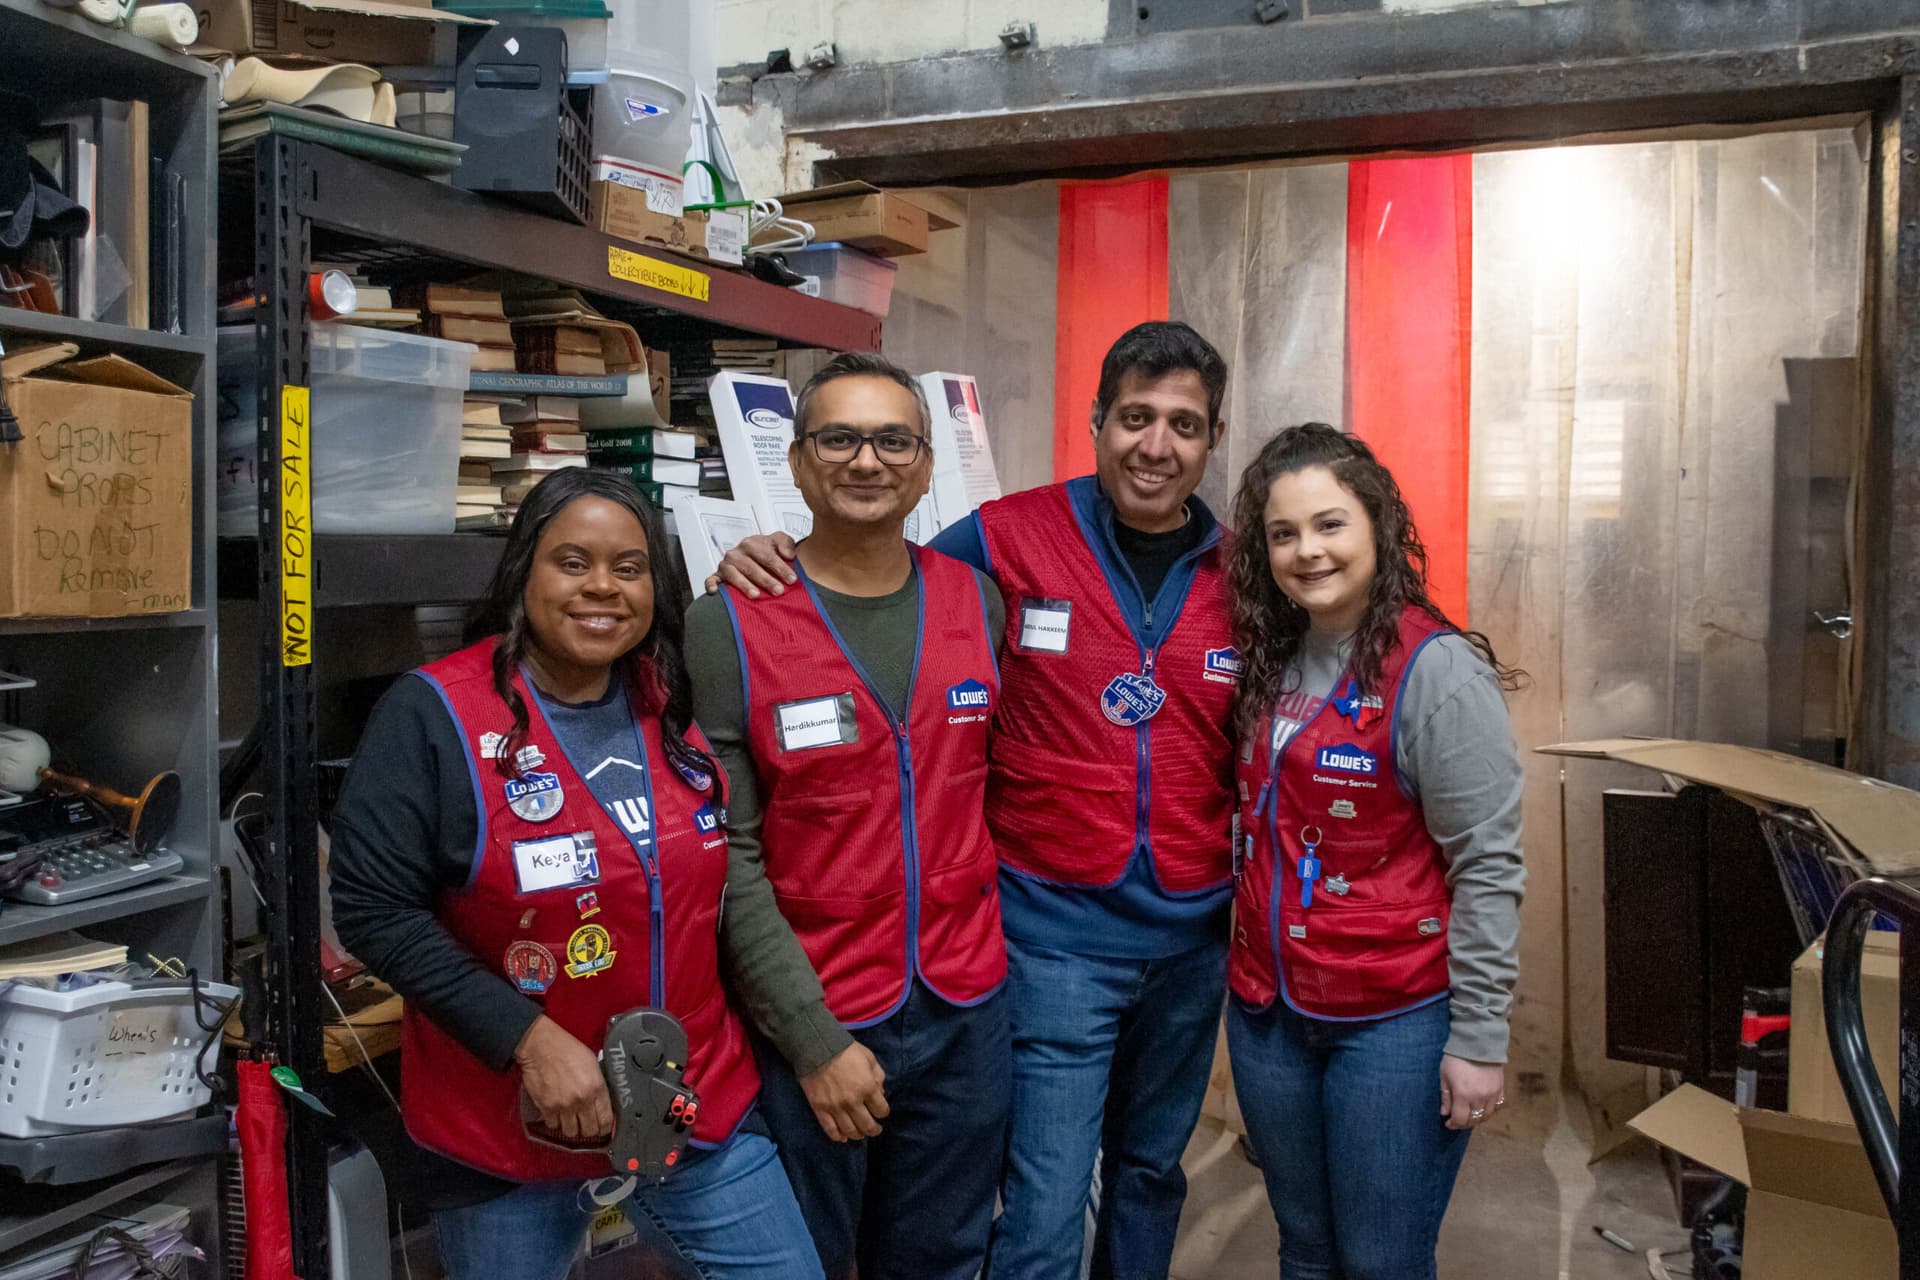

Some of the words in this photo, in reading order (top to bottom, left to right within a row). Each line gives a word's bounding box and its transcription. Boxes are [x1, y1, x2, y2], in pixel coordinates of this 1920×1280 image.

[610, 260, 658, 284] COLLECTIBLE
[657, 273, 680, 289] BOOKS
[500, 376, 544, 389] GEOGRAPHIC
[545, 378, 566, 389] ATLAS
[566, 378, 575, 389] OF
[576, 379, 589, 390] THE
[590, 380, 614, 391] WORLD
[35, 420, 171, 467] CABINET
[281, 396, 304, 499] SALE
[600, 438, 614, 448] Golf
[60, 468, 153, 508] PROPS
[33, 526, 81, 560] DO
[88, 522, 161, 559] NOT
[283, 509, 306, 579] FOR
[59, 556, 153, 593] Remove
[284, 588, 308, 657] NOT
[951, 689, 988, 707] LOWE'S
[1114, 682, 1147, 711] LOWE'S
[784, 717, 837, 733] Hardikkumar
[947, 715, 976, 725] Customer
[1320, 749, 1373, 773] LOWE'S
[1312, 773, 1347, 786] Customer
[1348, 778, 1377, 789] Service
[531, 851, 571, 870] Keya
[608, 1039, 634, 1109] THOMAS
